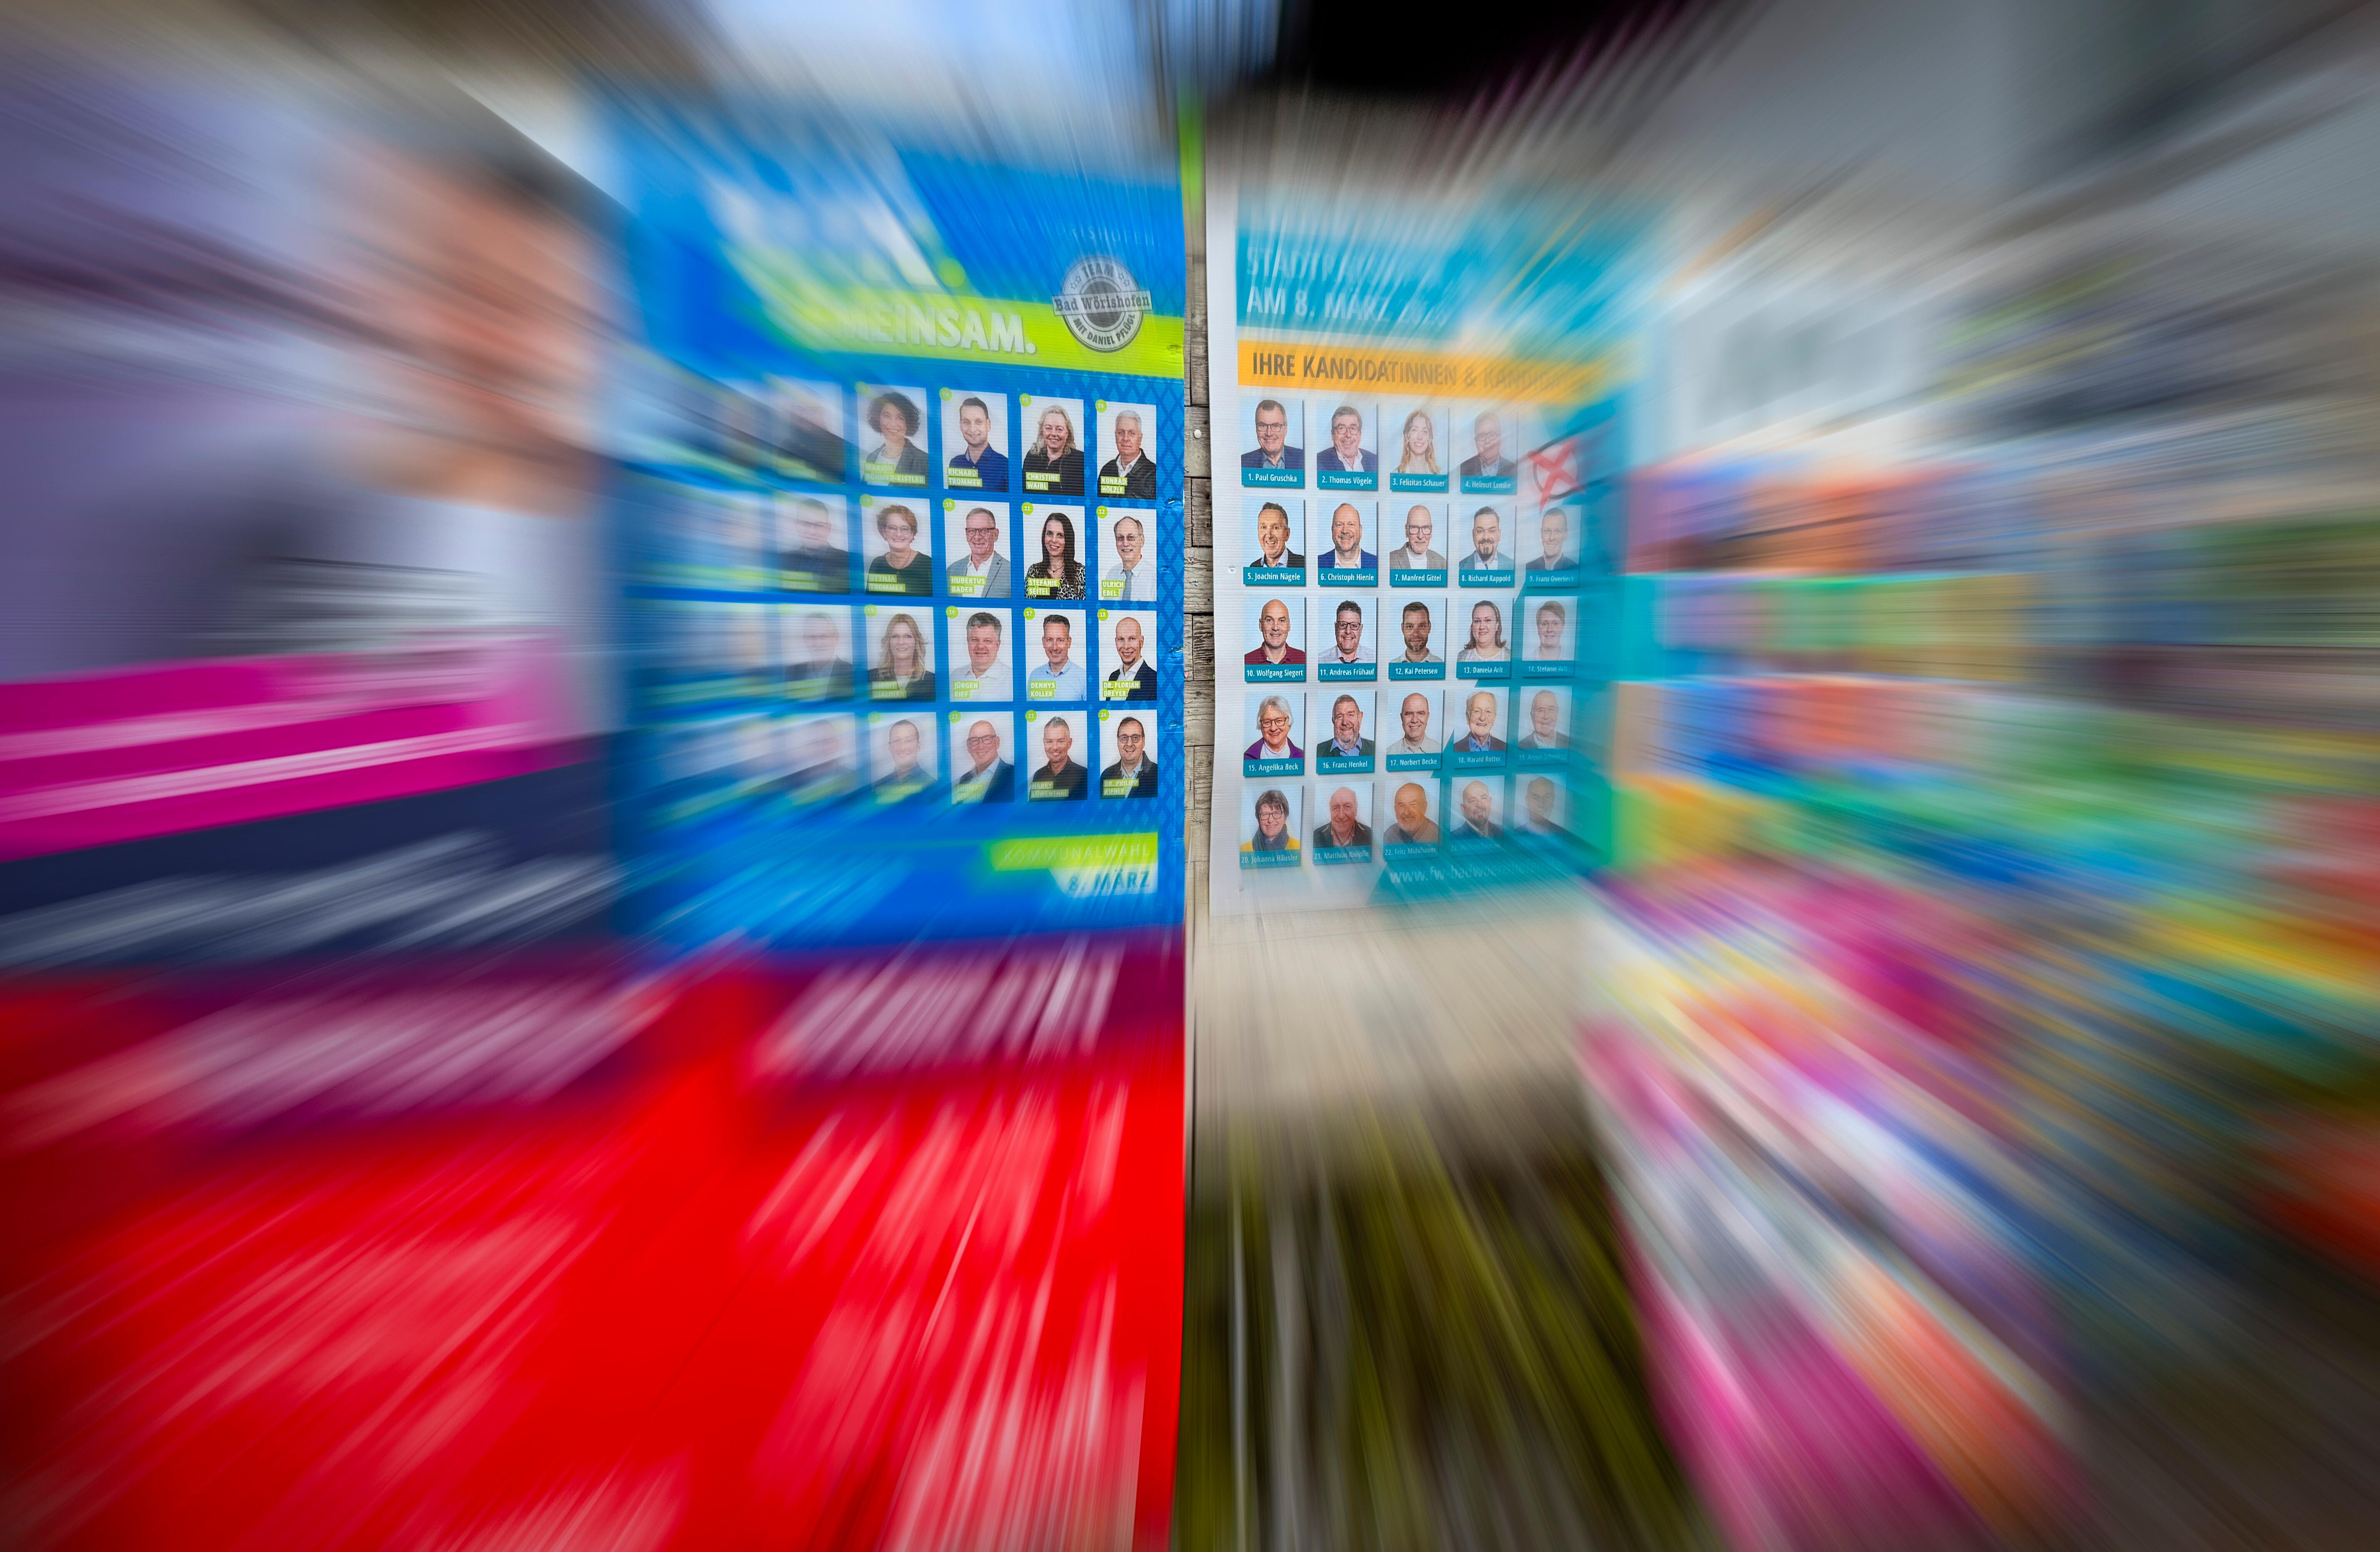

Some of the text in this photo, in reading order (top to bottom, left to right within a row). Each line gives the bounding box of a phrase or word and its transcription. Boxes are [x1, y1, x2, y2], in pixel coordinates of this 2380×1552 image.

[1081, 263, 1114, 277] TEAM
[1054, 294, 1150, 312] Bad Wörishofen
[1247, 287, 1285, 315] AM
[1295, 290, 1315, 317] 8.
[832, 303, 1036, 354] MEINSAM.
[1073, 314, 1135, 345] MIT DANIEL PFLÜGL
[1253, 352, 1295, 377] IHRE
[1303, 355, 1457, 386] KANDIDATINNEN
[1464, 365, 1477, 387] &
[948, 468, 977, 477] RICHARD
[1353, 477, 1372, 486] Vögele
[1255, 572, 1278, 581] Joachim
[1280, 573, 1300, 582] Nägele
[1328, 573, 1354, 582] Christoph
[1489, 575, 1511, 583] Rappold
[1256, 669, 1282, 678] Wolfgang
[1285, 669, 1303, 678] Siegert
[954, 681, 978, 690] JÜRGEN
[1258, 764, 1284, 772] Angelika
[1003, 842, 1150, 863] KOMMUNALWAHL
[1349, 851, 1369, 860] Knöpfle
[1251, 855, 1275, 864] Johanna
[1068, 868, 1150, 892] 8. MÄRZ
